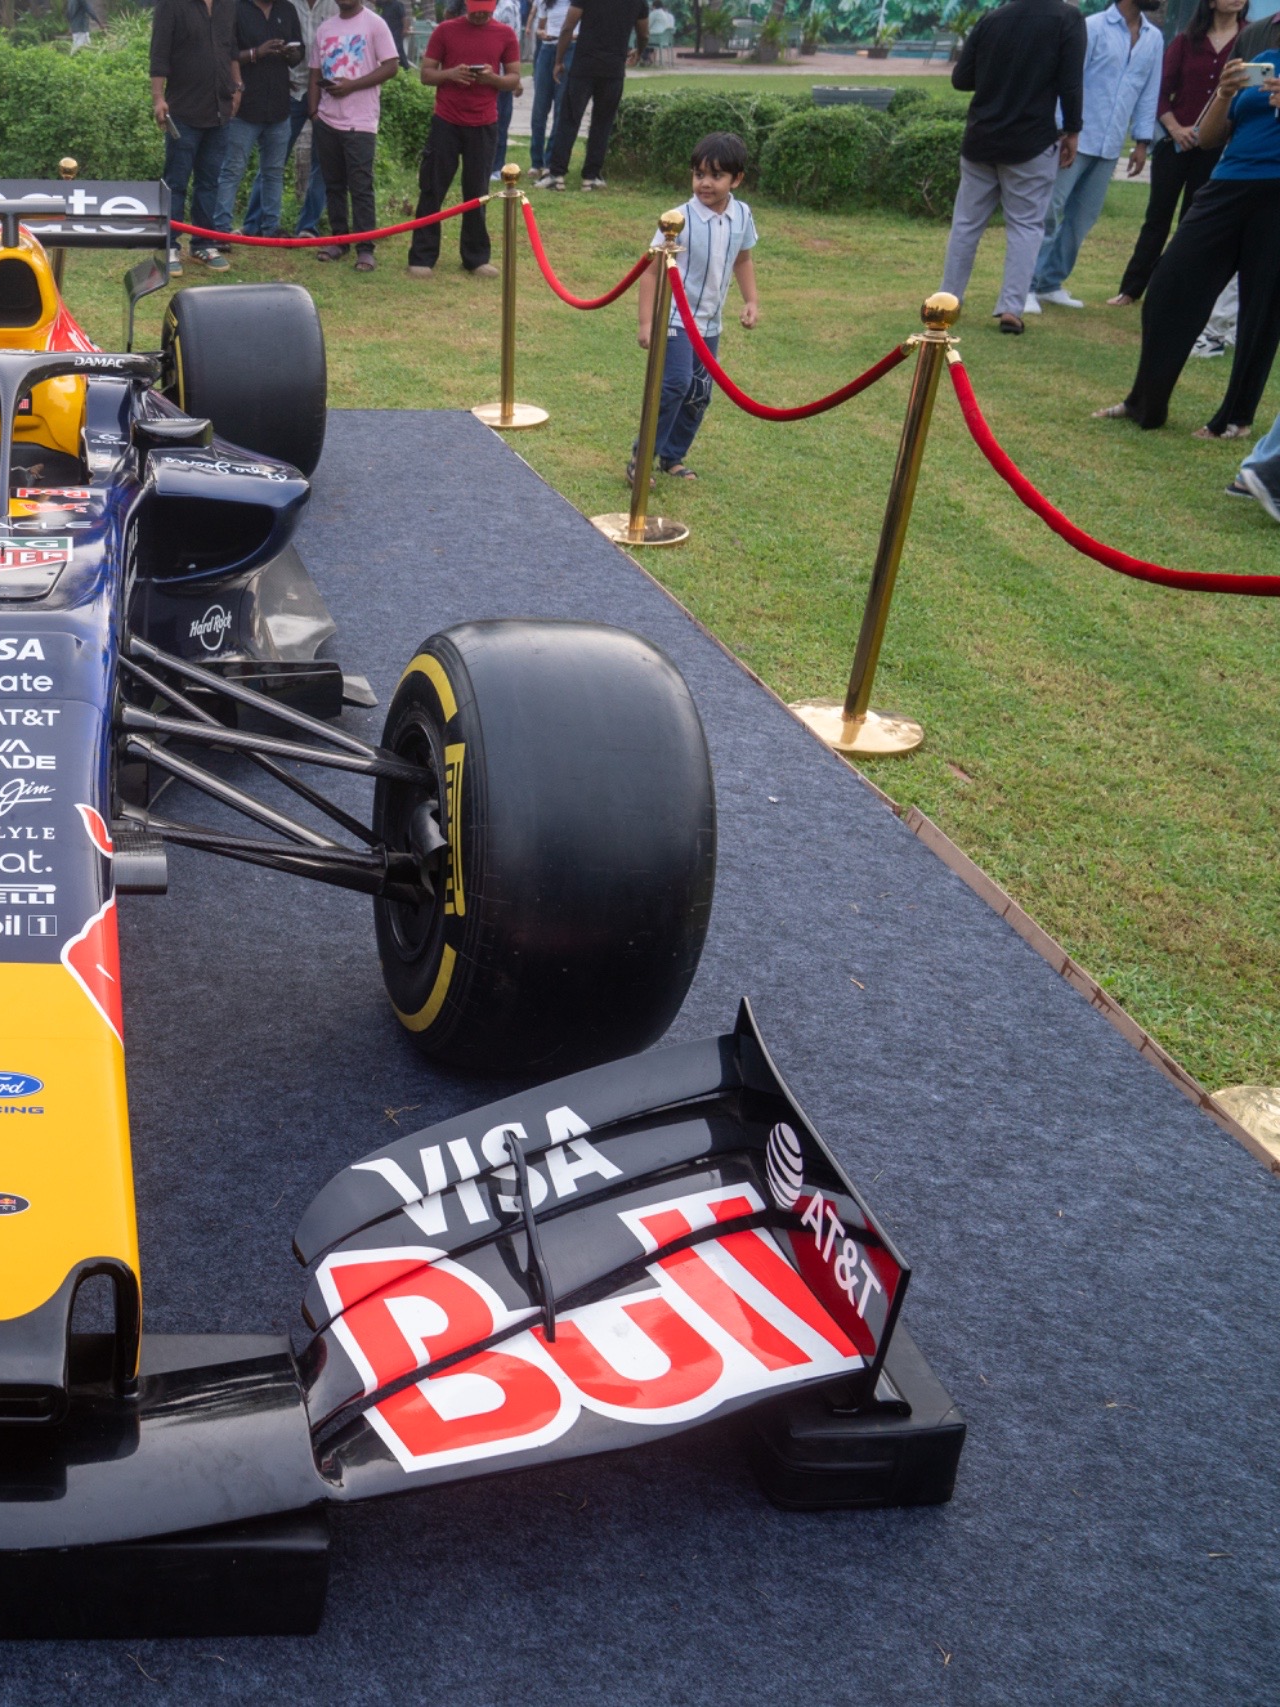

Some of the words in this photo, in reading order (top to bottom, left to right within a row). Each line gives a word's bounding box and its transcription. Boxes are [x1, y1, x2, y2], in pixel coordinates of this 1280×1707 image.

[74, 355, 126, 369] DAMAC
[189, 617, 214, 638] Hard
[213, 610, 233, 634] Rock
[351, 1105, 624, 1238] VISA
[799, 1190, 883, 1320] AT&T
[315, 1181, 865, 1473] Bull
